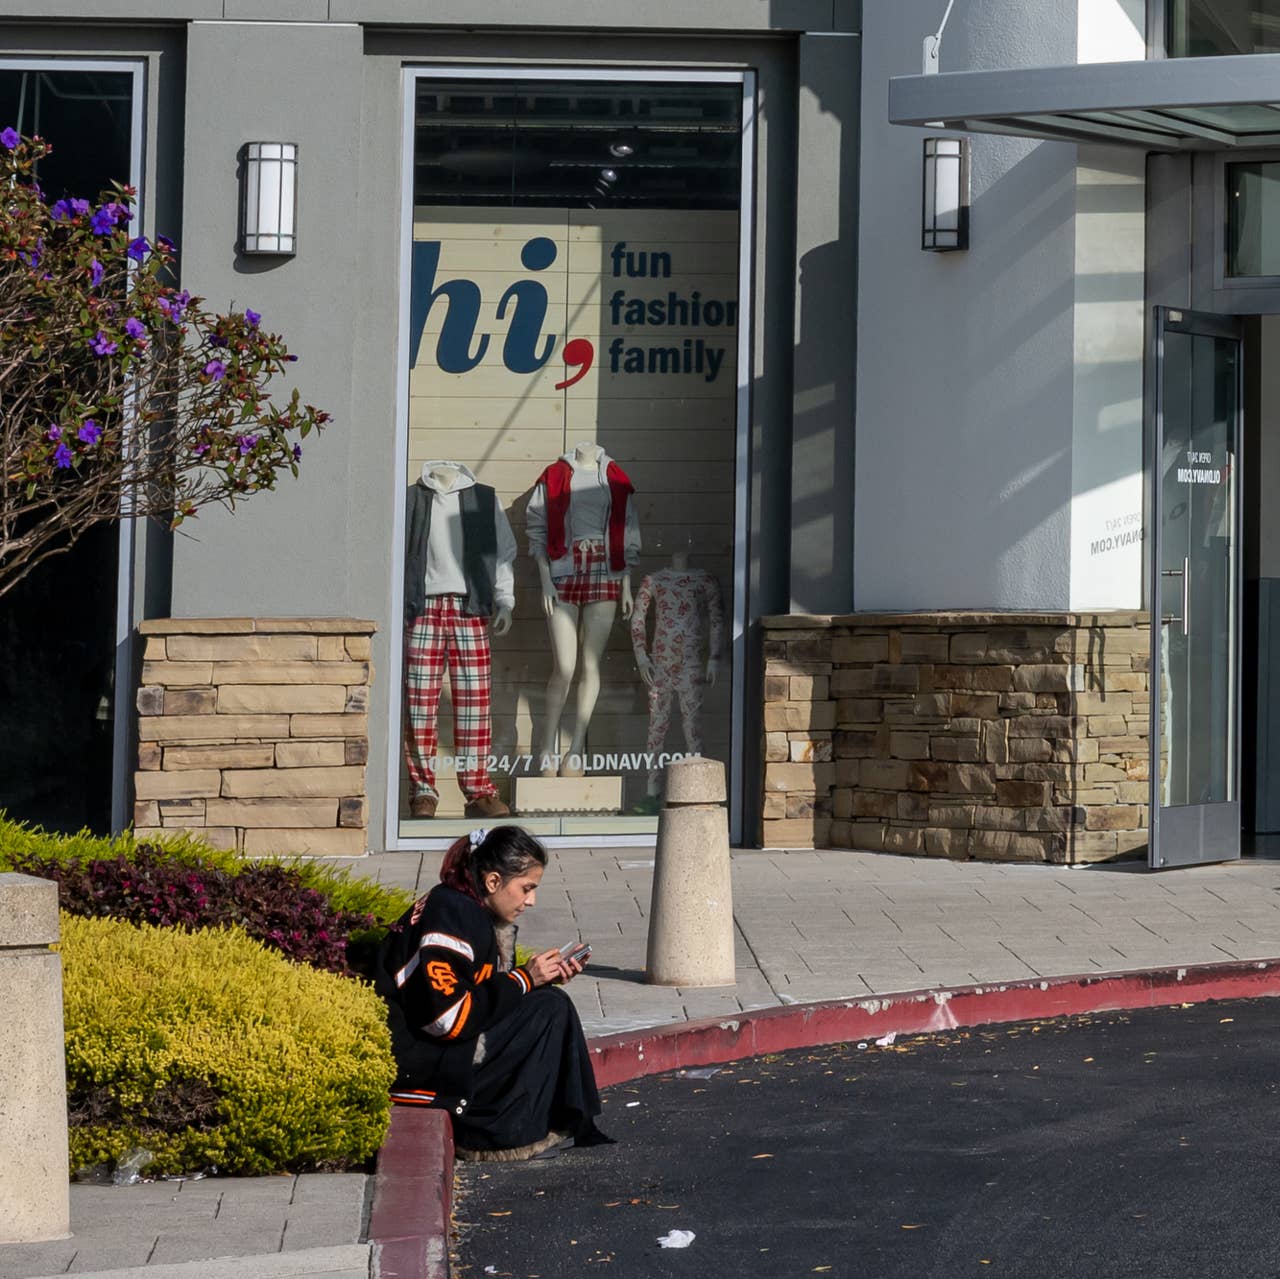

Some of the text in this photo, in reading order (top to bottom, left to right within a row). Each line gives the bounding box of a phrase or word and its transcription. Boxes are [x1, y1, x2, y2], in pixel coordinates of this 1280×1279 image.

[610, 242, 672, 278] fun
[609, 338, 725, 383] family
[429, 754, 478, 772] OPEN
[486, 754, 533, 775] 24/7
[540, 753, 562, 772] AT
